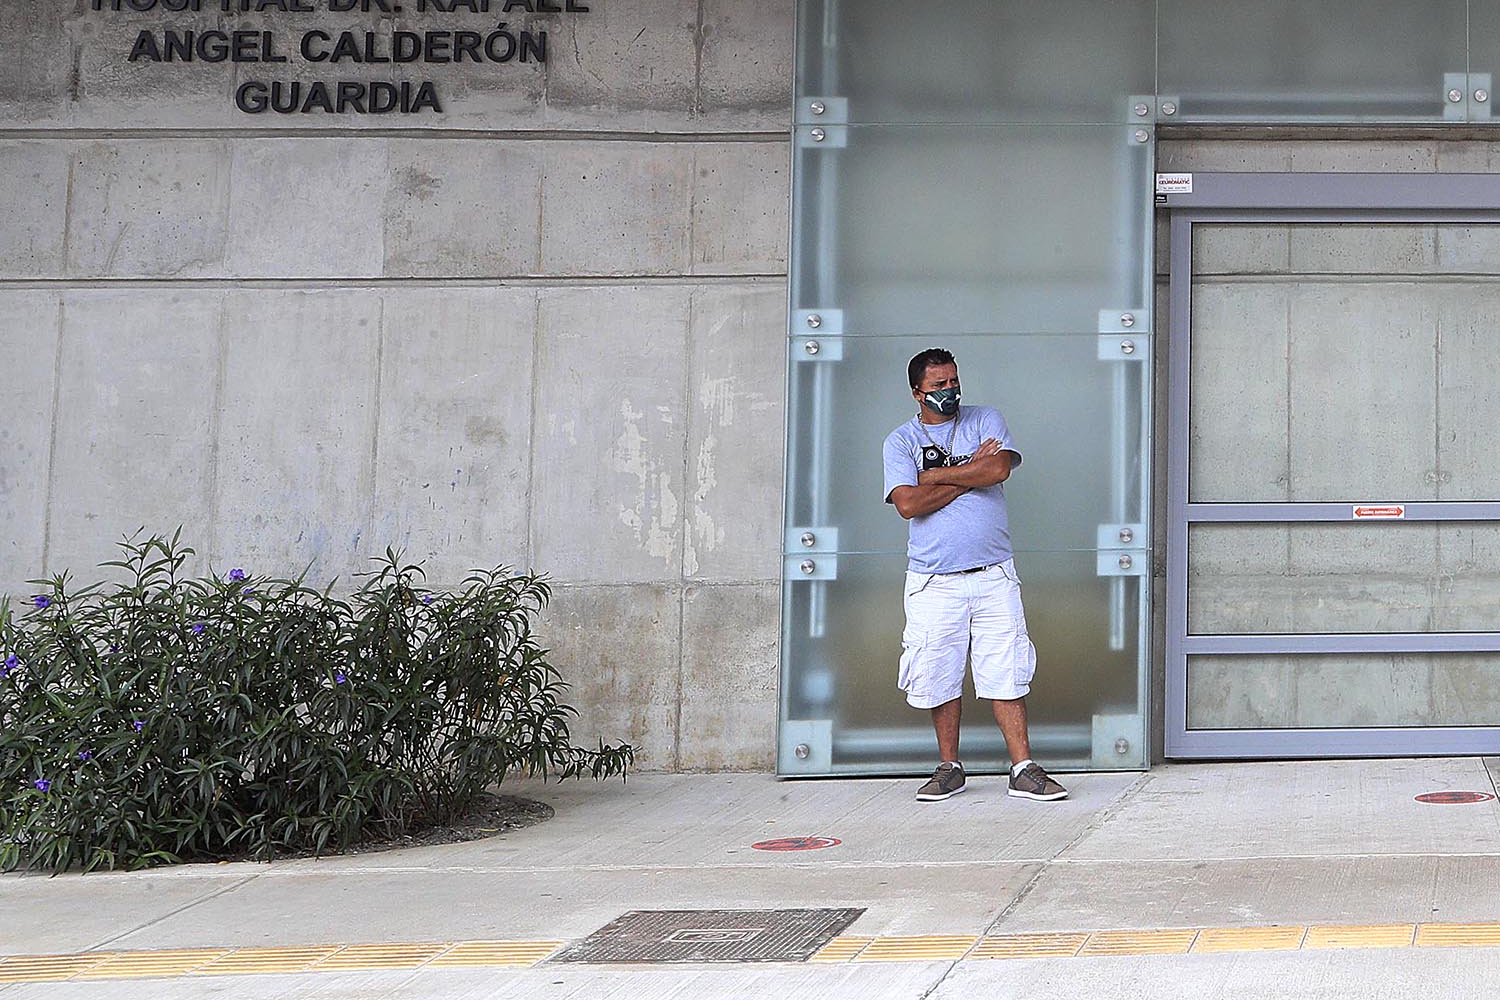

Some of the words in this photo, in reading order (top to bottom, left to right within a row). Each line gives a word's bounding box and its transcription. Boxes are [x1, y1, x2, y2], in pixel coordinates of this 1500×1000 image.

[127, 30, 287, 63] ANGEL
[300, 22, 546, 63] CALDERÓN
[235, 81, 443, 114] GUARDIA
